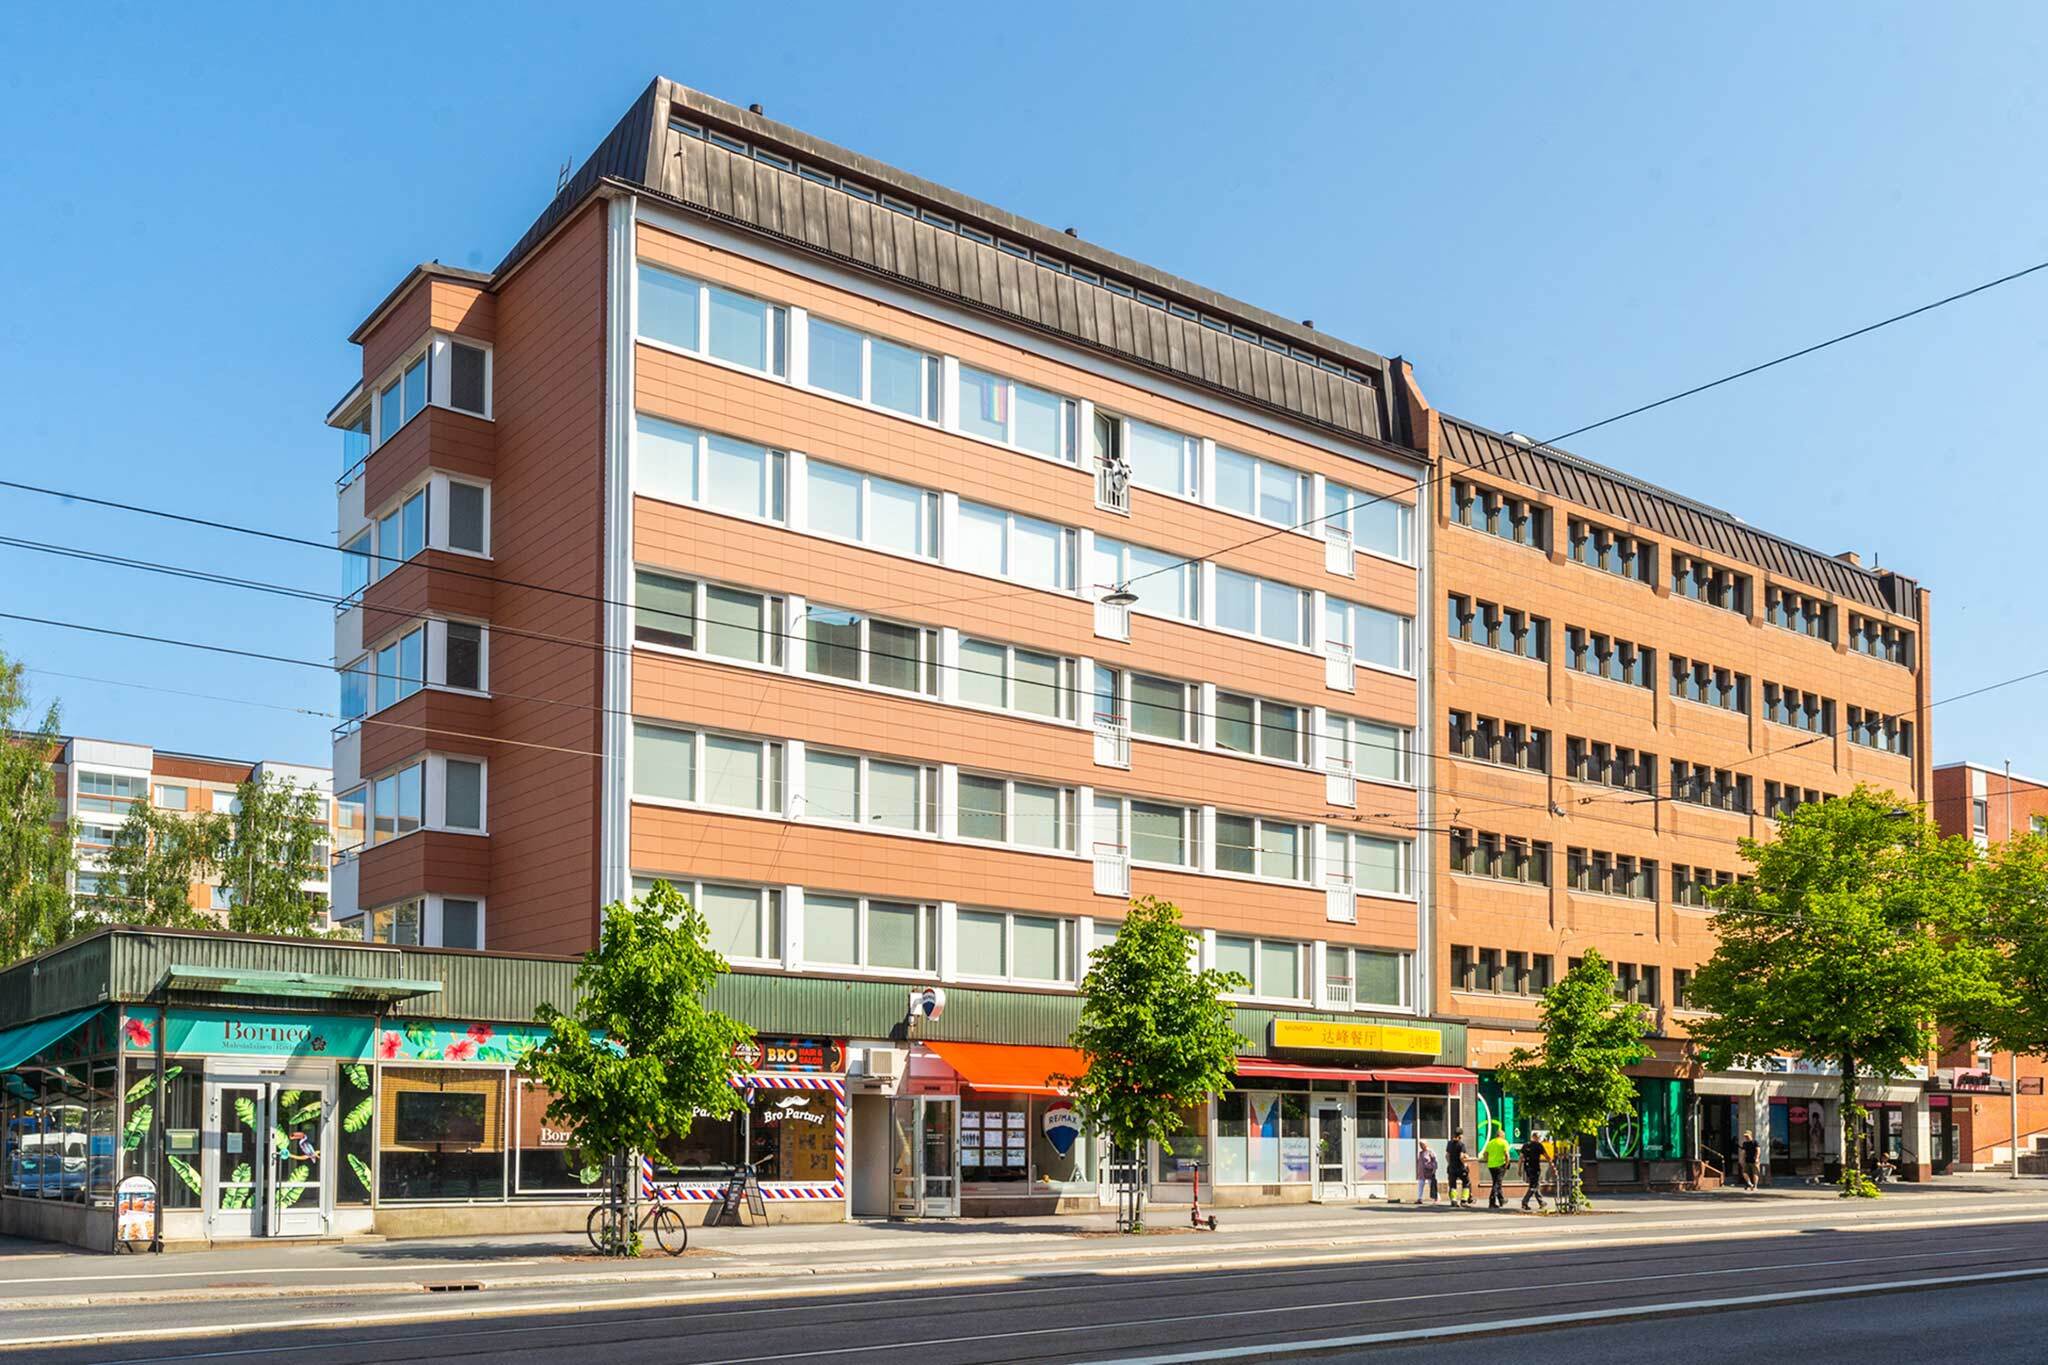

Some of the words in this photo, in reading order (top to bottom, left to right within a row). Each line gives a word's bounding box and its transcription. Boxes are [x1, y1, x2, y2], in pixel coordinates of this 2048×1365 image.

[223, 1019, 311, 1042] Borneo
[1321, 1028, 1377, 1047] 达峰餐厅
[766, 1048, 797, 1063] BRO
[763, 1111, 784, 1124] Bro
[784, 1107, 826, 1125] Parturi
[1048, 1113, 1078, 1125] RE/MAX
